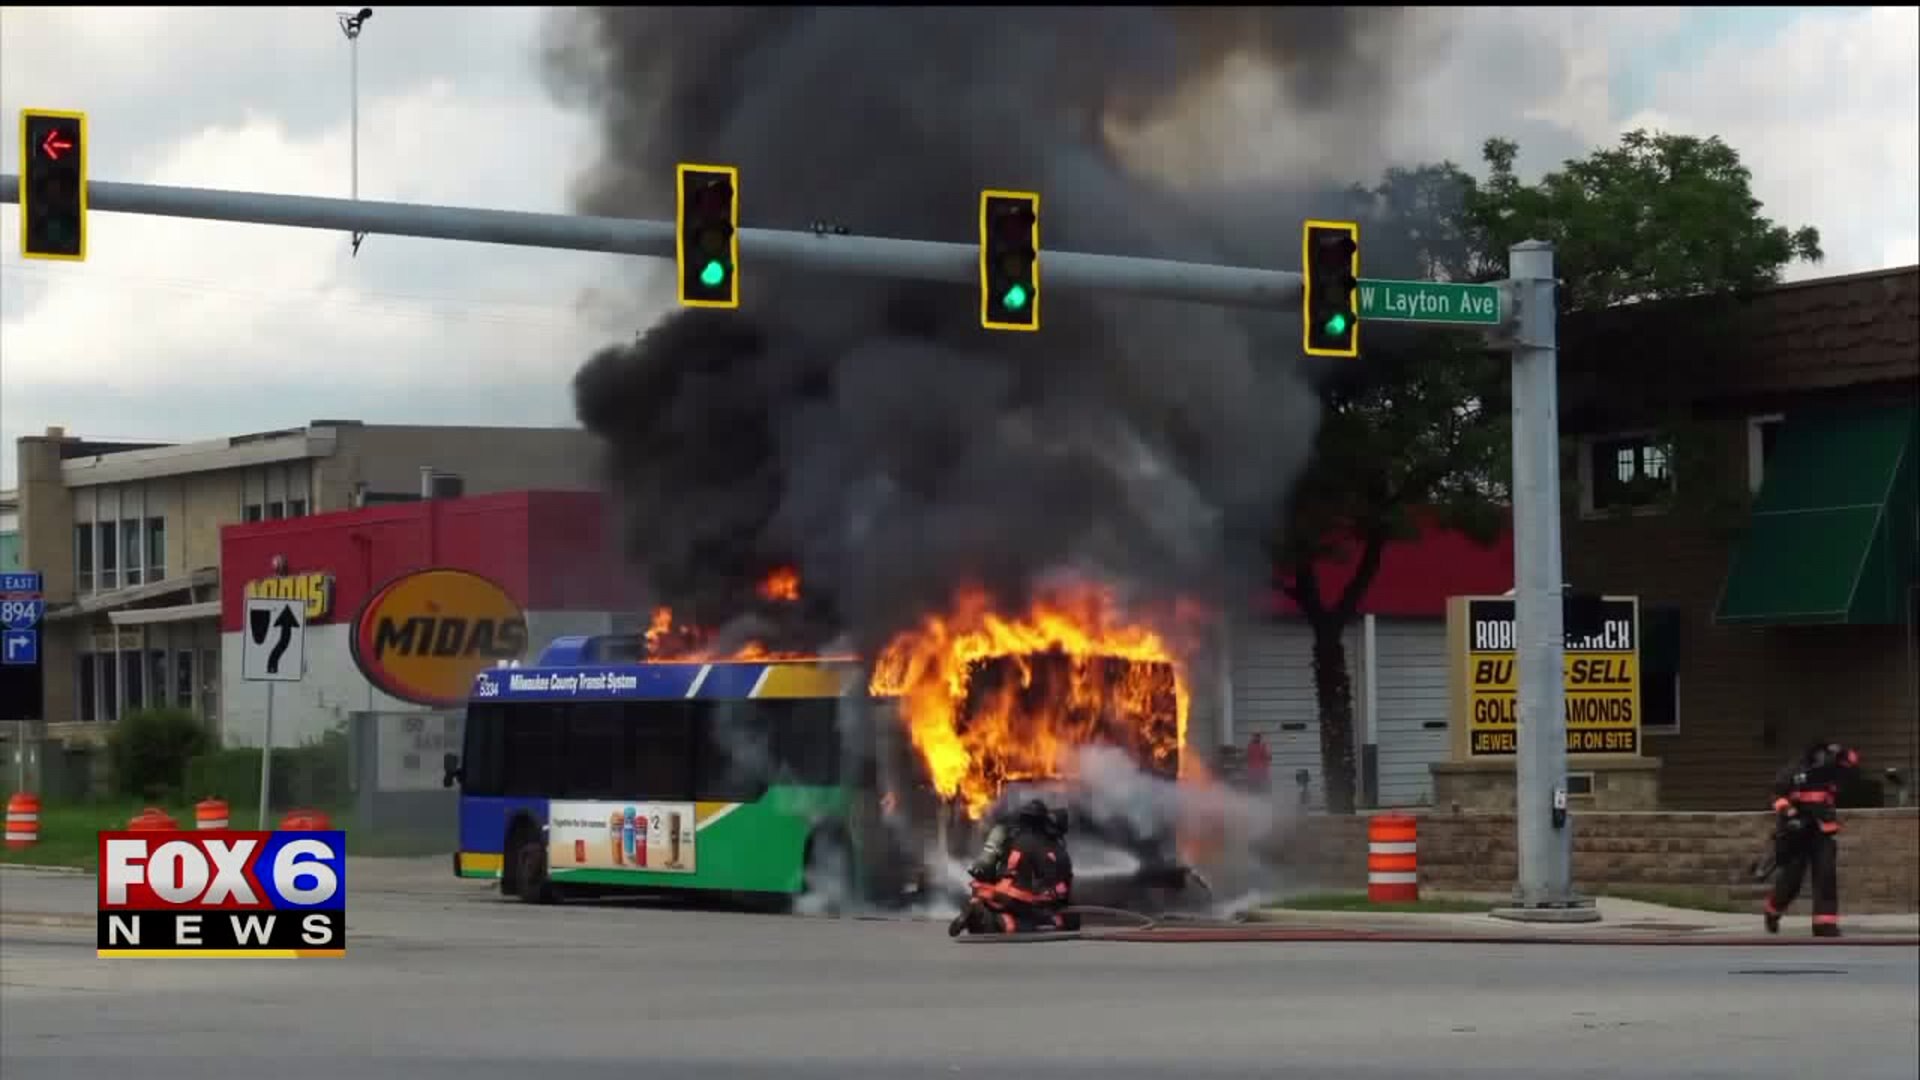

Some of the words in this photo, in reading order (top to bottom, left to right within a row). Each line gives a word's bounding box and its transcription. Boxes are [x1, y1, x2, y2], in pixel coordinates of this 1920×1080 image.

[1361, 287, 1375, 312] W
[1385, 287, 1450, 317] Layton
[1460, 291, 1494, 315] Ave
[4, 576, 32, 589] EAST
[1, 602, 36, 622] 894
[374, 614, 527, 661] MIDAS
[1475, 659, 1514, 684] BU
[479, 681, 499, 697] 5334
[550, 672, 577, 695] County
[578, 671, 606, 690] Transit
[607, 671, 637, 694] System
[1584, 732, 1603, 749] ON
[1606, 732, 1633, 749] SITE
